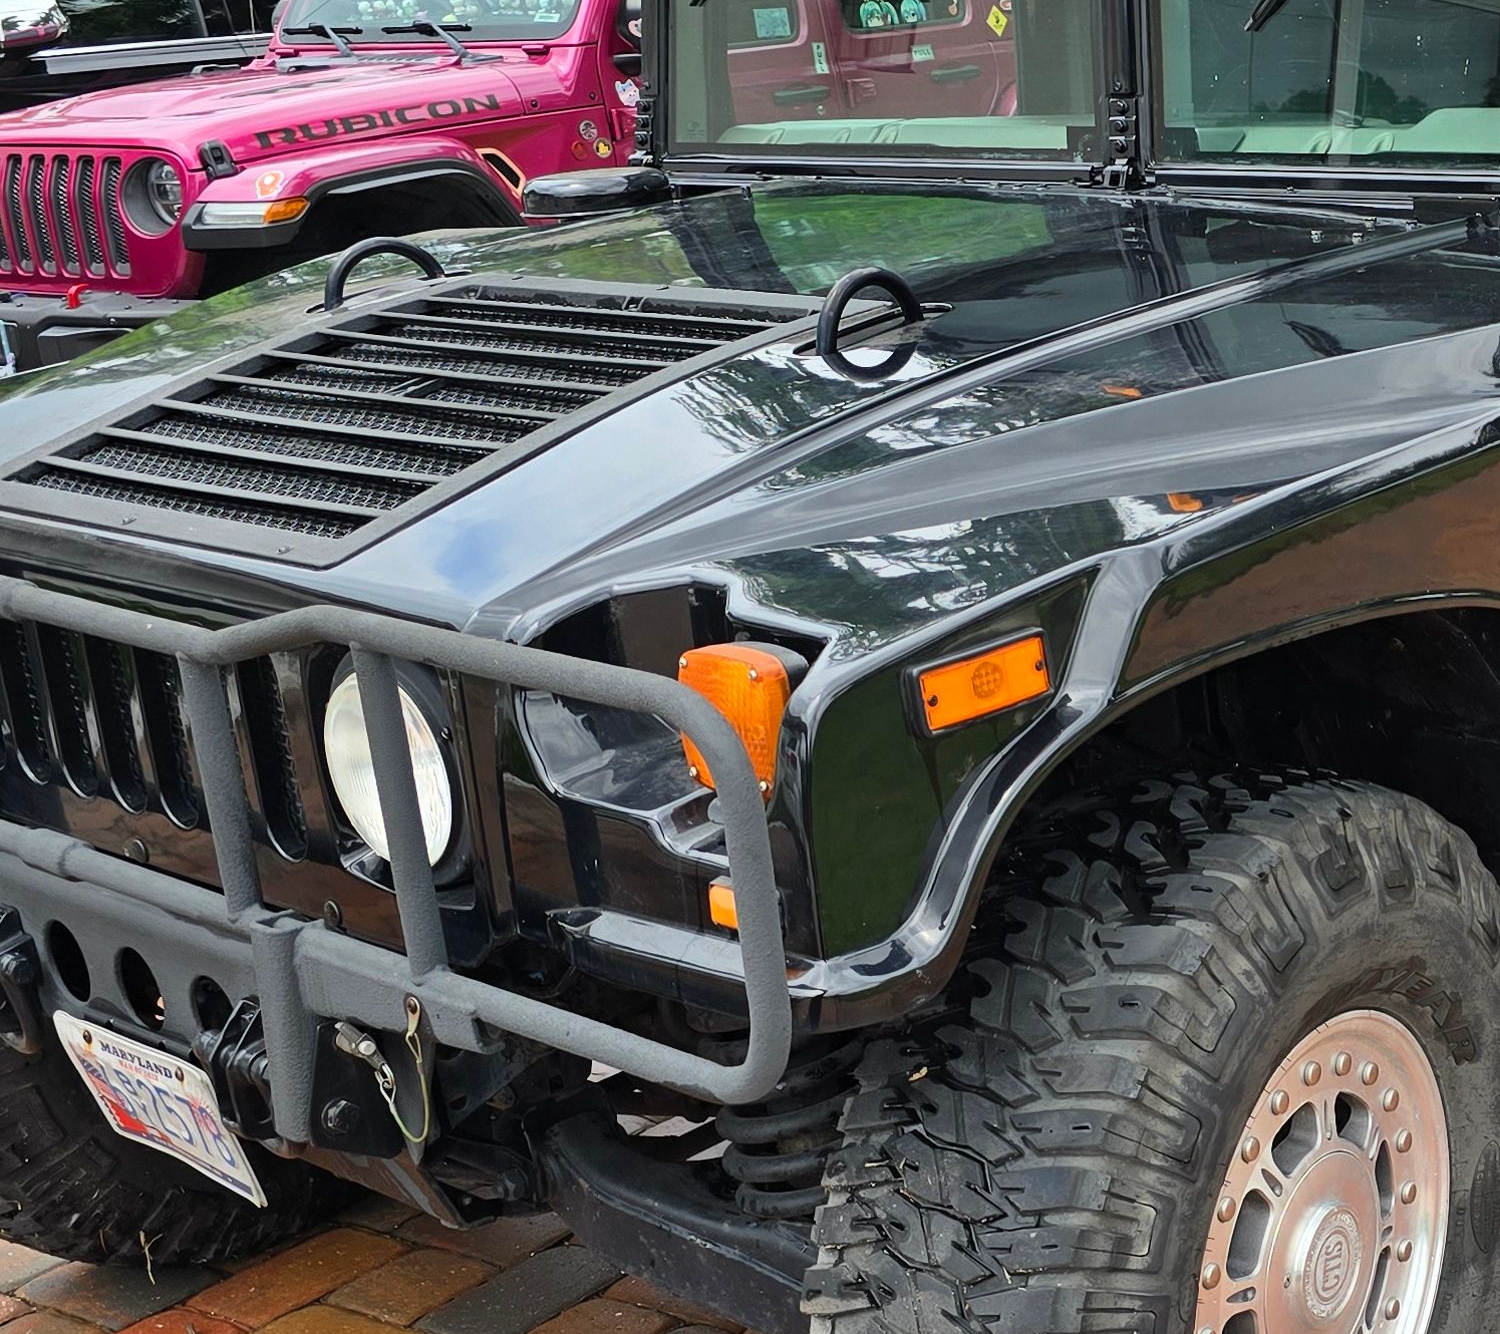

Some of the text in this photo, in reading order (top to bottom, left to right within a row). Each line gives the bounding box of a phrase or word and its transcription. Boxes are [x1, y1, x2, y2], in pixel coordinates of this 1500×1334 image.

[254, 94, 501, 149] RUBICON
[98, 1040, 173, 1079] MARYLAND
[1321, 1239, 1344, 1293] CTIS
